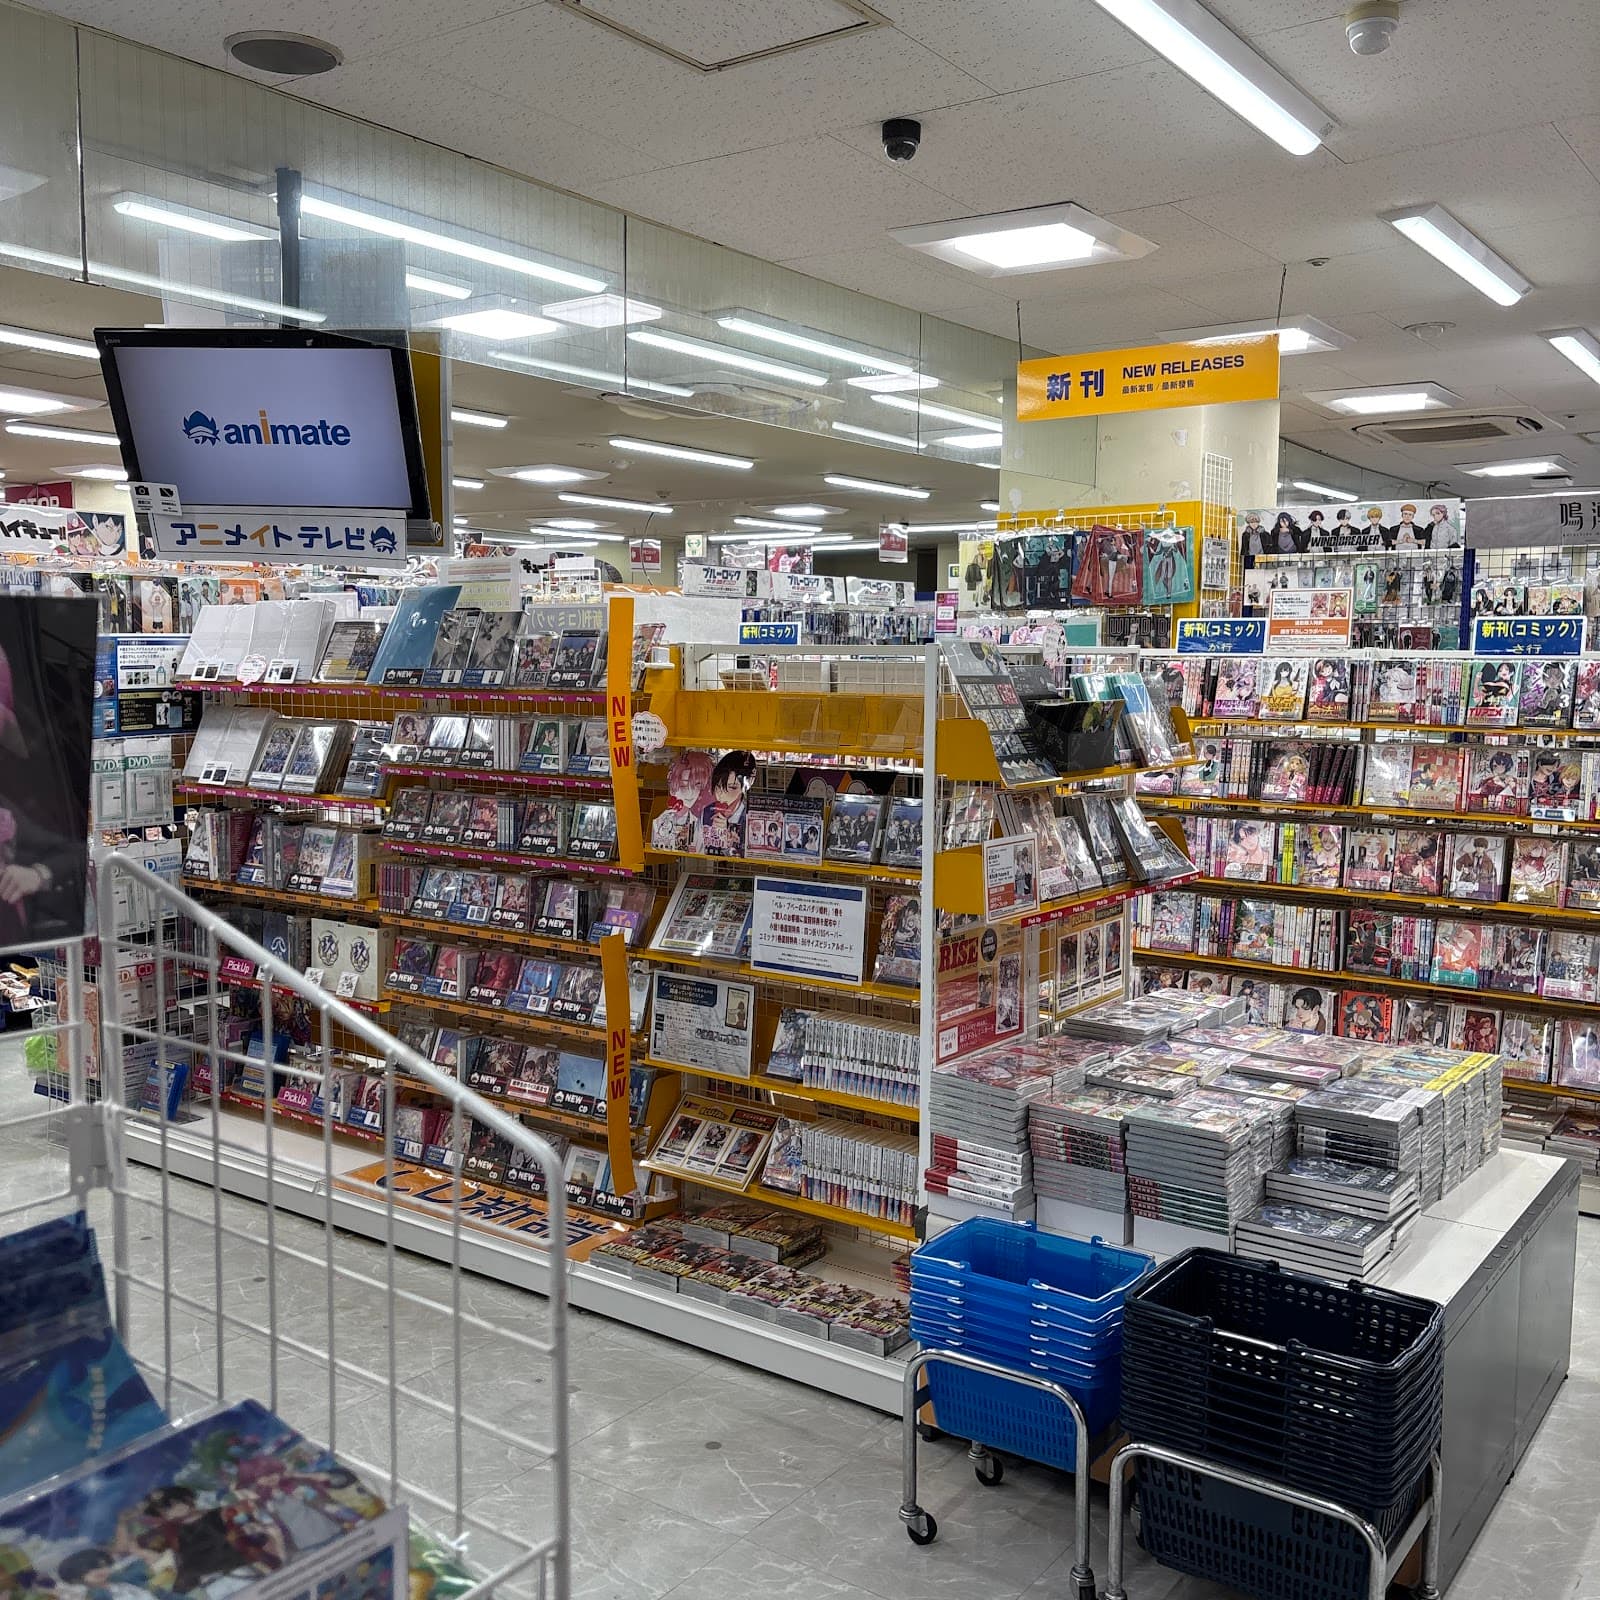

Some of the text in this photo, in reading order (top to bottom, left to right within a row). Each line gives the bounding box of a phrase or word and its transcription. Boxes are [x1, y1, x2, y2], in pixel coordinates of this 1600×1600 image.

[1123, 355, 1245, 379] NEW RELEASES
[1046, 368, 1104, 401] 新刊
[223, 410, 351, 446] animate
[171, 523, 365, 551] アニメイト テレビ
[1311, 534, 1380, 548] WIND BREAKER
[702, 567, 741, 580] ブルーロック
[742, 626, 796, 639] 新刊(コミック)
[1183, 623, 1261, 638] 新刊(コミック)
[1481, 620, 1577, 638] 新刊(コミック)
[561, 672, 580, 681] NEW
[1559, 694, 1570, 708] 3
[612, 696, 630, 767] NEW
[471, 751, 488, 760] NEW
[128, 757, 150, 768] DVD
[395, 824, 411, 832] NEW
[433, 826, 449, 835] NEW
[473, 831, 491, 840] NEW
[532, 837, 550, 846] NEW
[581, 841, 600, 850] NEW
[423, 900, 440, 910] NEW
[501, 911, 519, 921] NEW
[547, 918, 566, 928] NEW
[938, 937, 979, 973] RISE
[138, 964, 153, 976] CD
[227, 959, 250, 975] Pick Up
[398, 973, 415, 983] NEW
[480, 988, 498, 998] NEW
[563, 1002, 581, 1012] NEW
[612, 1028, 627, 1100] NEW
[479, 1074, 497, 1084] NEW
[283, 1091, 308, 1107] Pick Up
[564, 1093, 583, 1103] NEW
[476, 1159, 494, 1169] NEW
[517, 1171, 535, 1182] NEW
[565, 1184, 582, 1194] NEW
[606, 1197, 626, 1207] NEW
